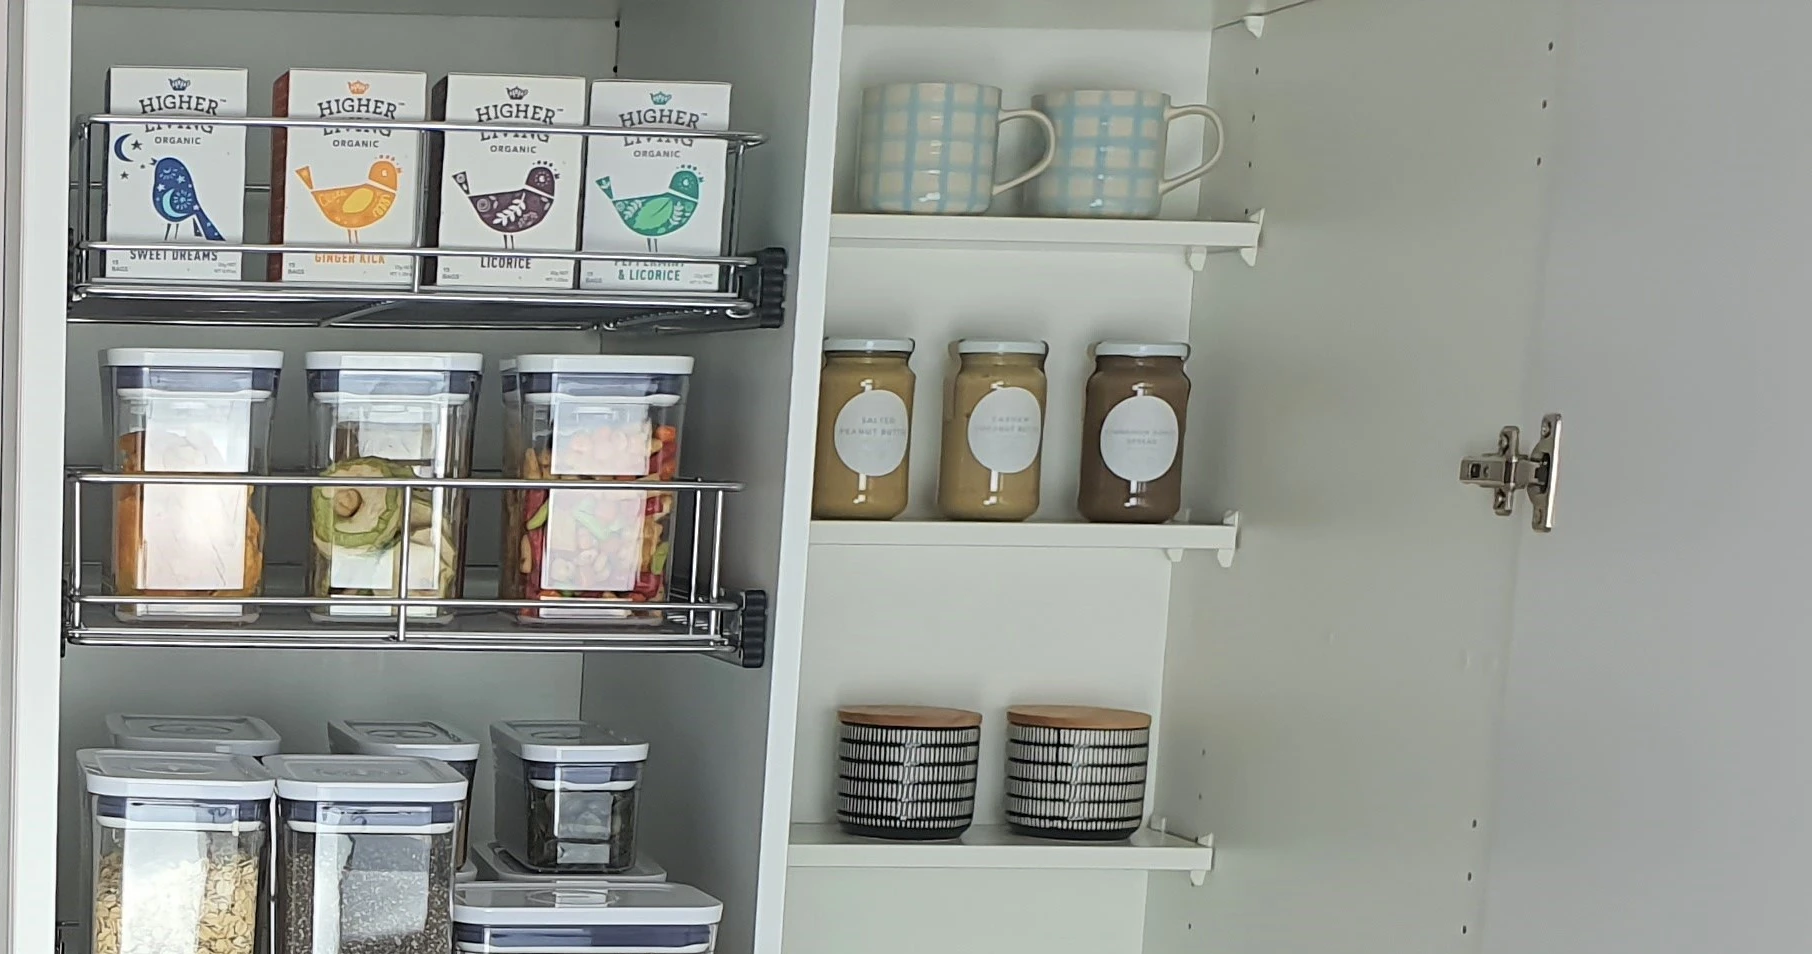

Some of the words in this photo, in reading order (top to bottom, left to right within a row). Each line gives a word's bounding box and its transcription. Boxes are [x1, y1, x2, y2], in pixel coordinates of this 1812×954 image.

[139, 95, 218, 115] HIGHER
[317, 97, 397, 120] HIGHER
[475, 103, 556, 125] HIGHER
[619, 109, 700, 129] HIGHER
[154, 136, 201, 145] ORGANIC
[332, 139, 379, 148] ORGANIC
[490, 144, 537, 153] ORGANIC
[633, 150, 680, 158] ORGANIC
[130, 249, 167, 260] SWEET
[172, 250, 218, 261] DREAMS
[480, 256, 531, 269] LICORICE
[618, 269, 625, 280] &
[629, 269, 681, 281] LICORICE
